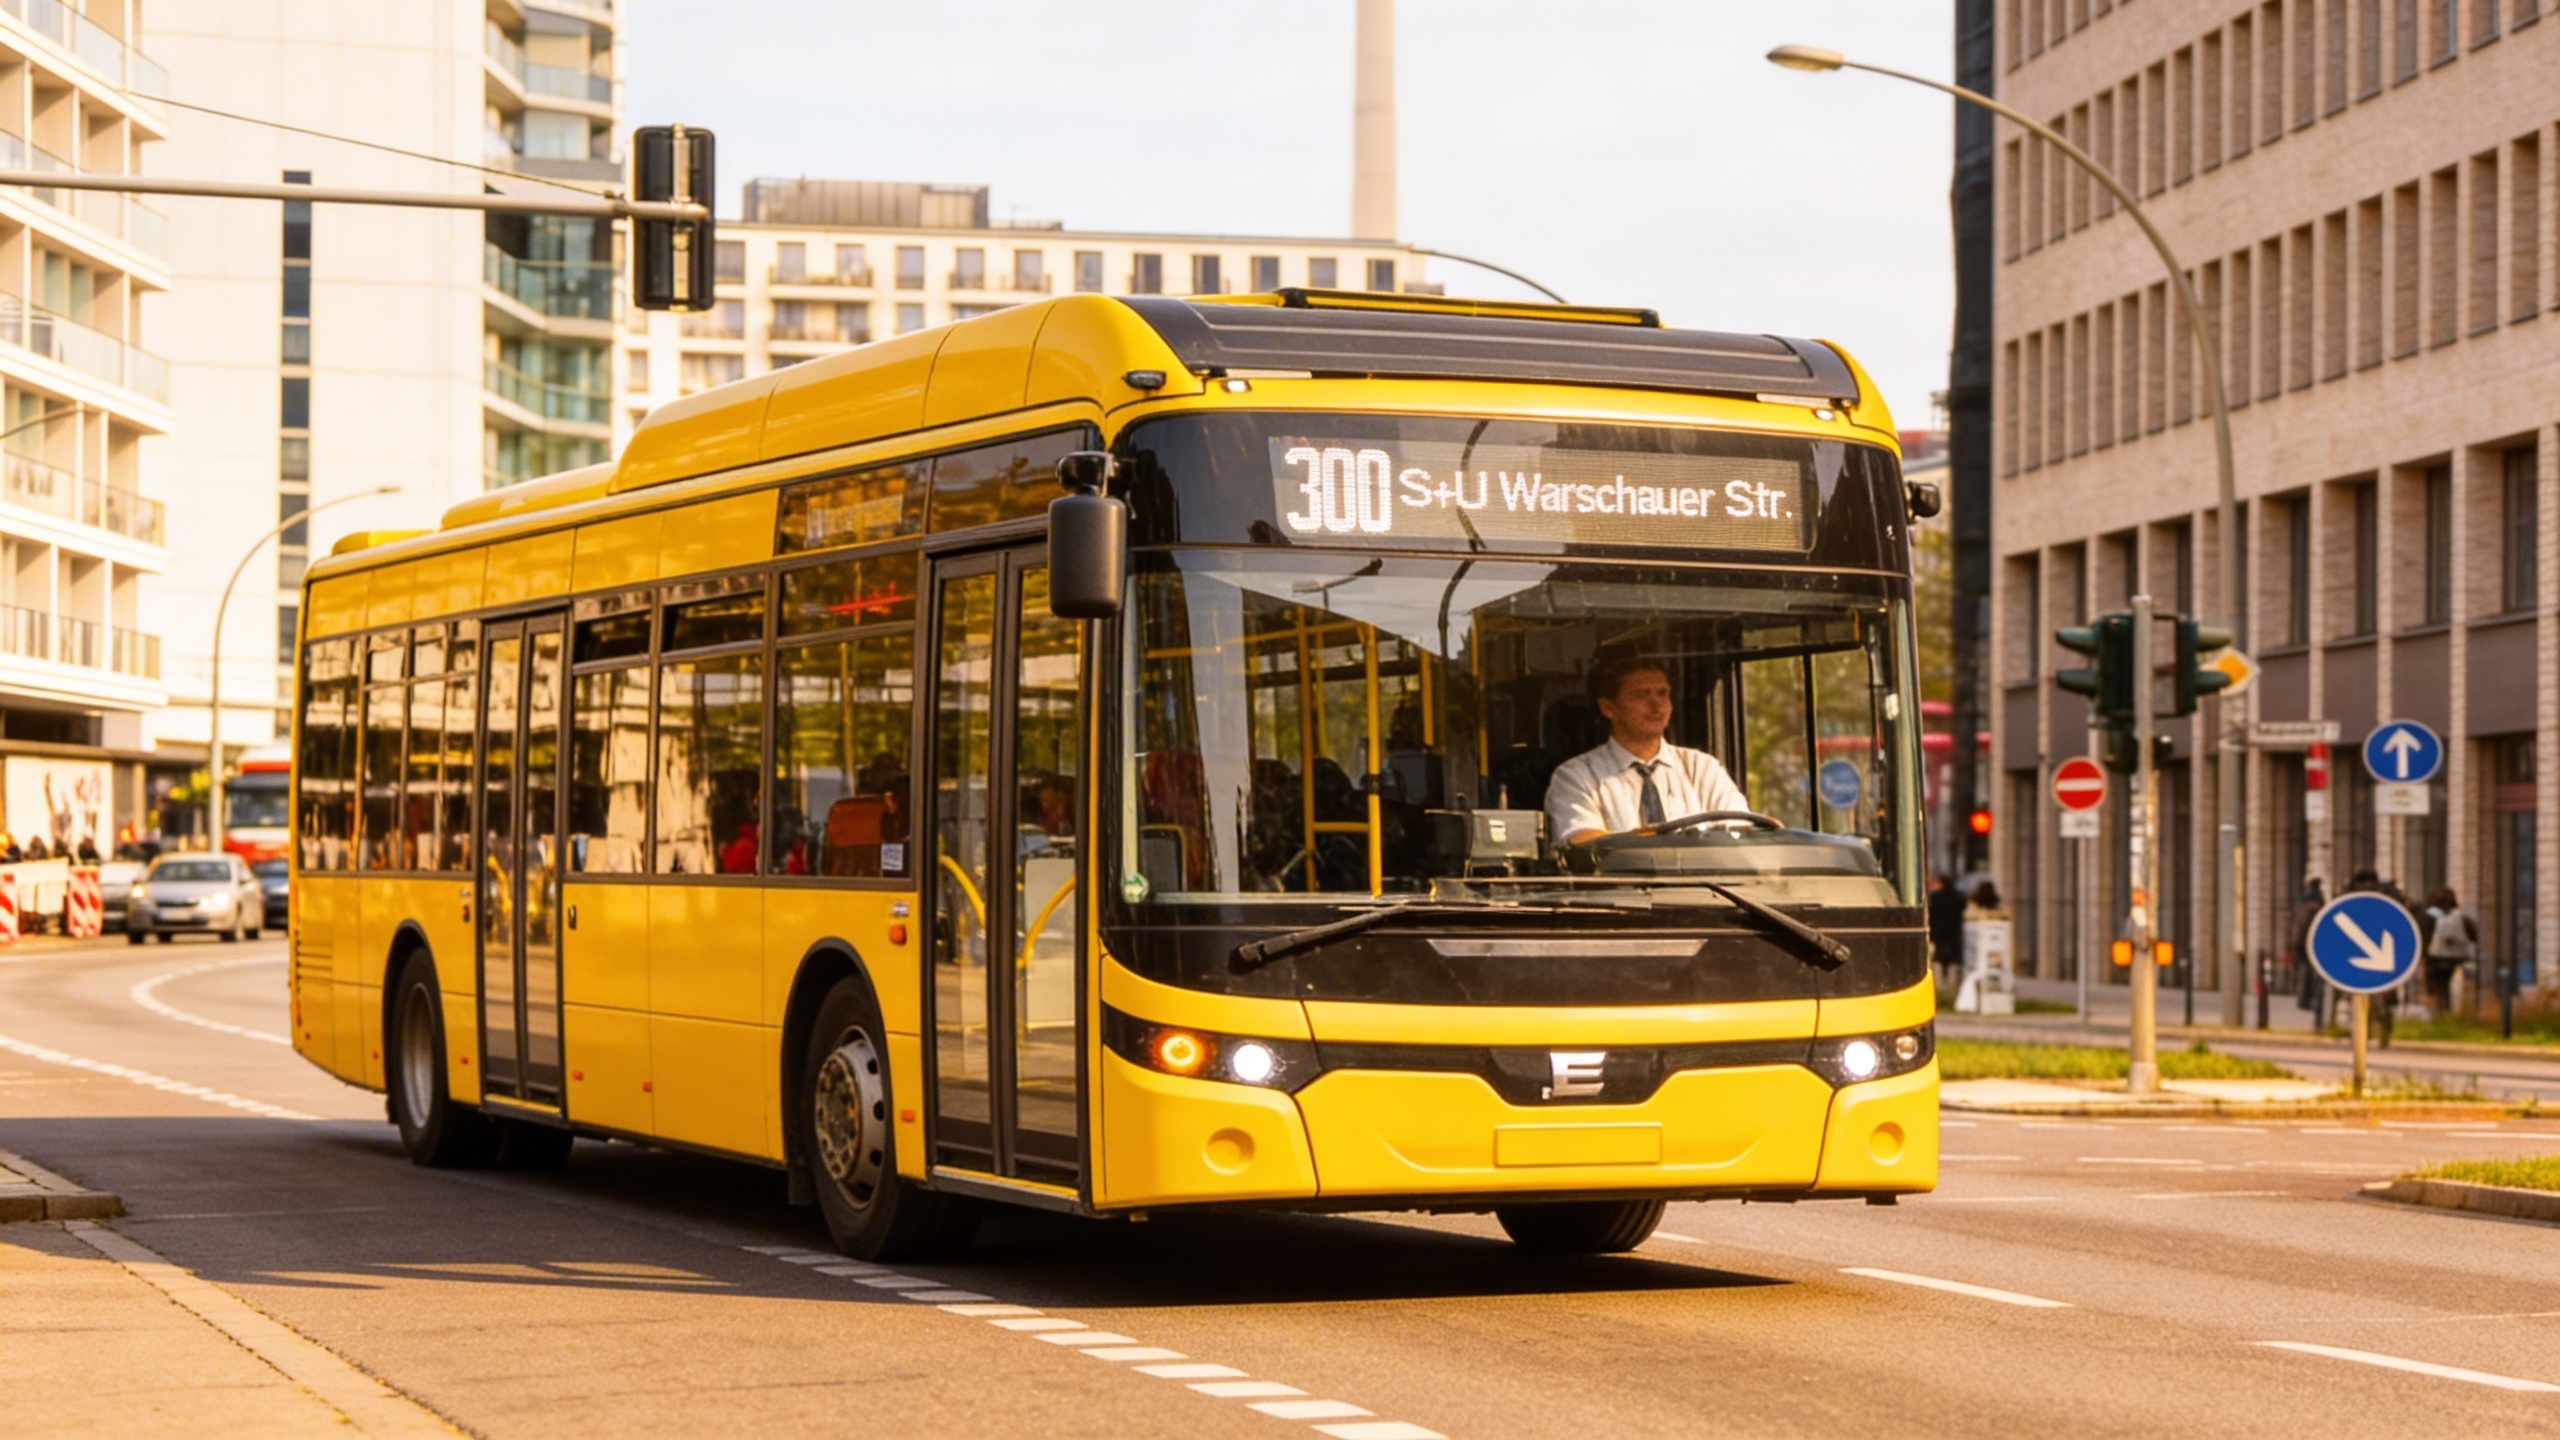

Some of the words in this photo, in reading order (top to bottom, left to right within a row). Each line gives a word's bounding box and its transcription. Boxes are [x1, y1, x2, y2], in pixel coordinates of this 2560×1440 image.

[1284, 447, 1392, 533] 300
[1399, 468, 1488, 510] S+U
[1499, 471, 1715, 518] Warschauer
[1725, 480, 1793, 519] Str.
